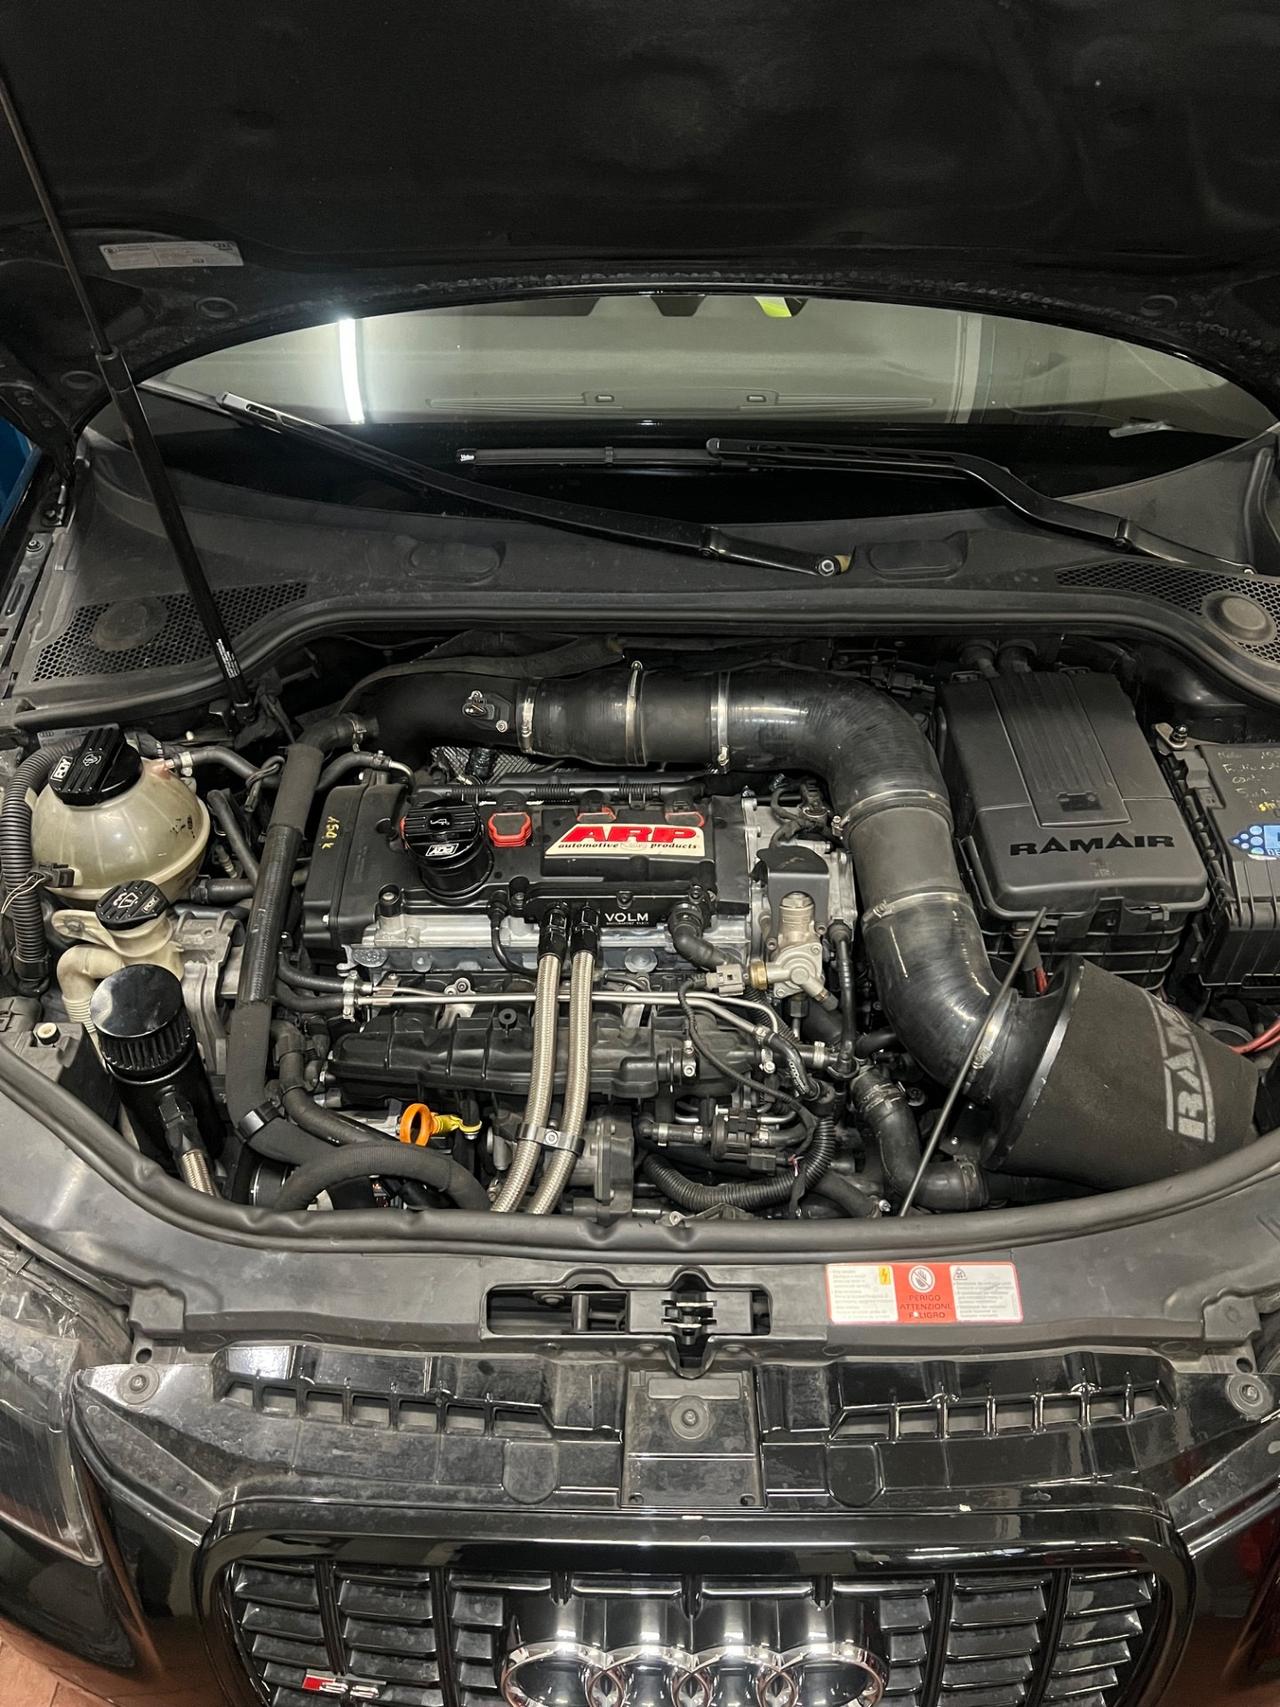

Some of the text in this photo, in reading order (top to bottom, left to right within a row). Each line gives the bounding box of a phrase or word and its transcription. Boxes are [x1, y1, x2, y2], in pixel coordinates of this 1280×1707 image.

[561, 826, 697, 843] ARP
[1010, 832, 1175, 856] RAMAIR
[604, 912, 649, 922] VOLM
[909, 1311, 946, 1319] PLIGRO
